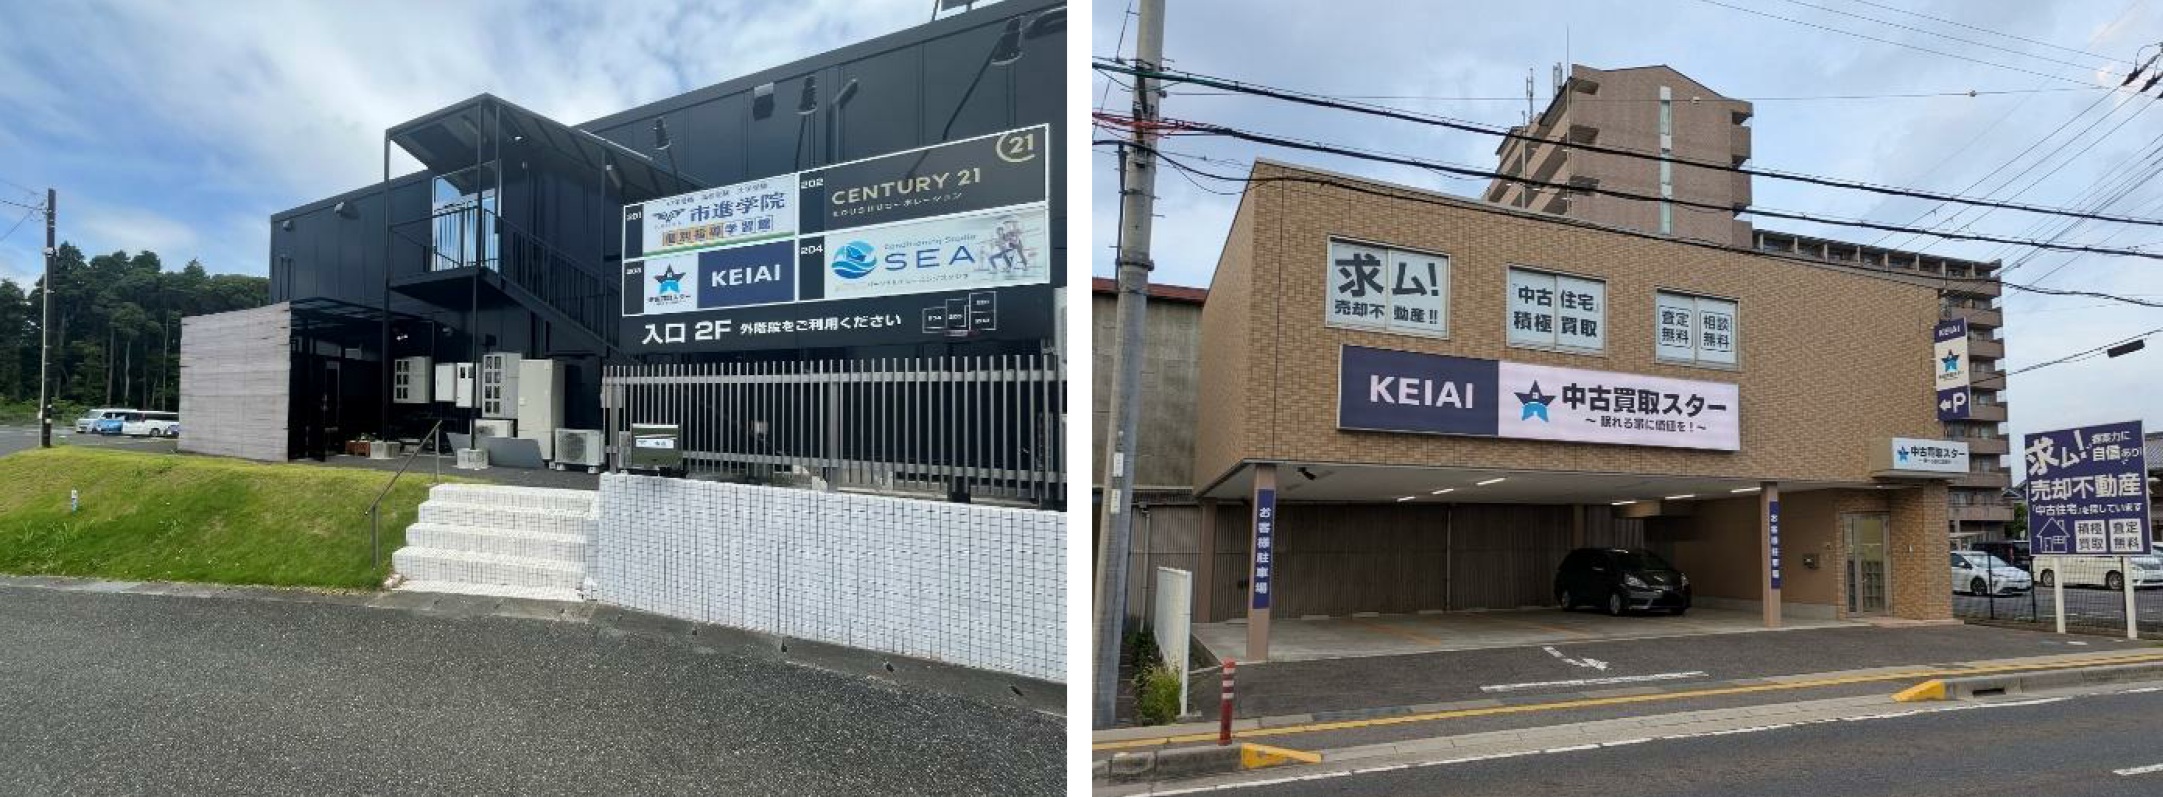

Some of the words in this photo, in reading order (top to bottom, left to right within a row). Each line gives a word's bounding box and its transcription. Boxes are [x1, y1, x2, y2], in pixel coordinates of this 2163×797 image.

[800, 178, 824, 189] 202
[831, 171, 950, 205] CENTURY
[957, 167, 981, 186] 21
[690, 191, 786, 222] 市進学院
[800, 243, 824, 255] 204
[885, 245, 977, 271] SEA
[711, 264, 782, 287] KEIAI
[641, 322, 687, 345] 入口
[694, 318, 732, 341] 2F
[740, 313, 902, 336] 外階段をご利用ください
[1513, 311, 1598, 338] 積極買取
[1662, 310, 1689, 328] 査定
[1703, 314, 1729, 332] 相談
[1662, 327, 1690, 345] 無料
[1703, 331, 1730, 349] 無料
[1370, 374, 1474, 409] KEIAI
[1561, 382, 1727, 418] 中古買取スター
[1952, 392, 1967, 414] P
[2030, 473, 2143, 502] 売却不動産
[1255, 506, 1271, 594] お客様駐車場
